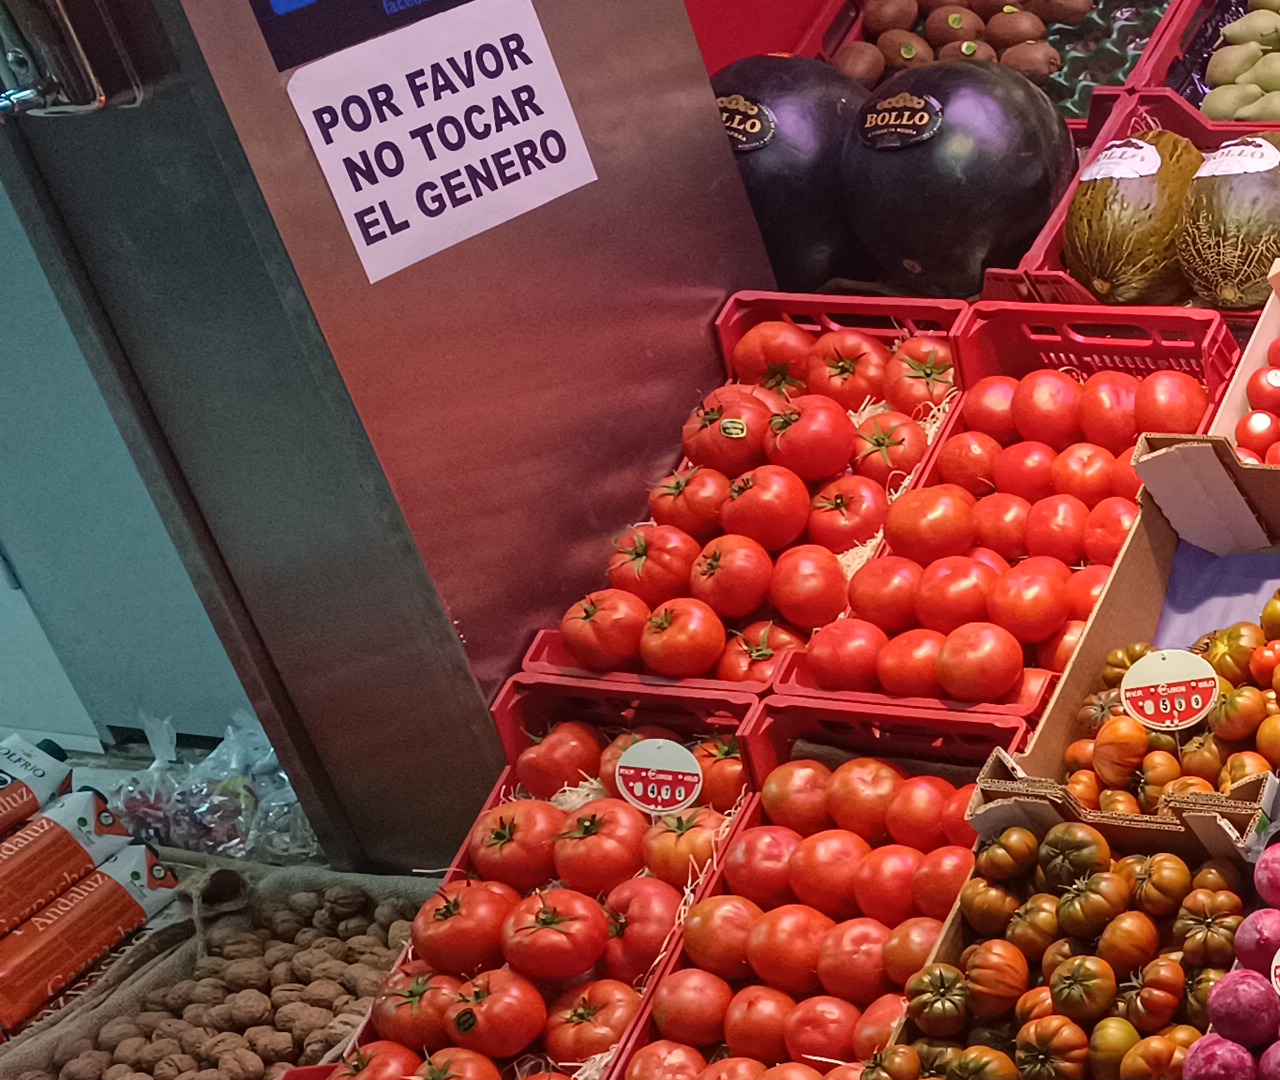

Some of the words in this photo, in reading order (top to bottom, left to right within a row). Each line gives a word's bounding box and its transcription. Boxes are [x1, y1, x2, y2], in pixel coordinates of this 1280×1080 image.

[312, 83, 404, 146] POR
[405, 33, 534, 109] FAVOR
[722, 112, 762, 134] LLO
[864, 111, 930, 128] BOLLO
[342, 141, 405, 193] NO
[409, 84, 545, 162] TOCAR
[354, 200, 411, 247] EL
[415, 129, 567, 218] GENERO
[30, 873, 109, 932] Andaluz
